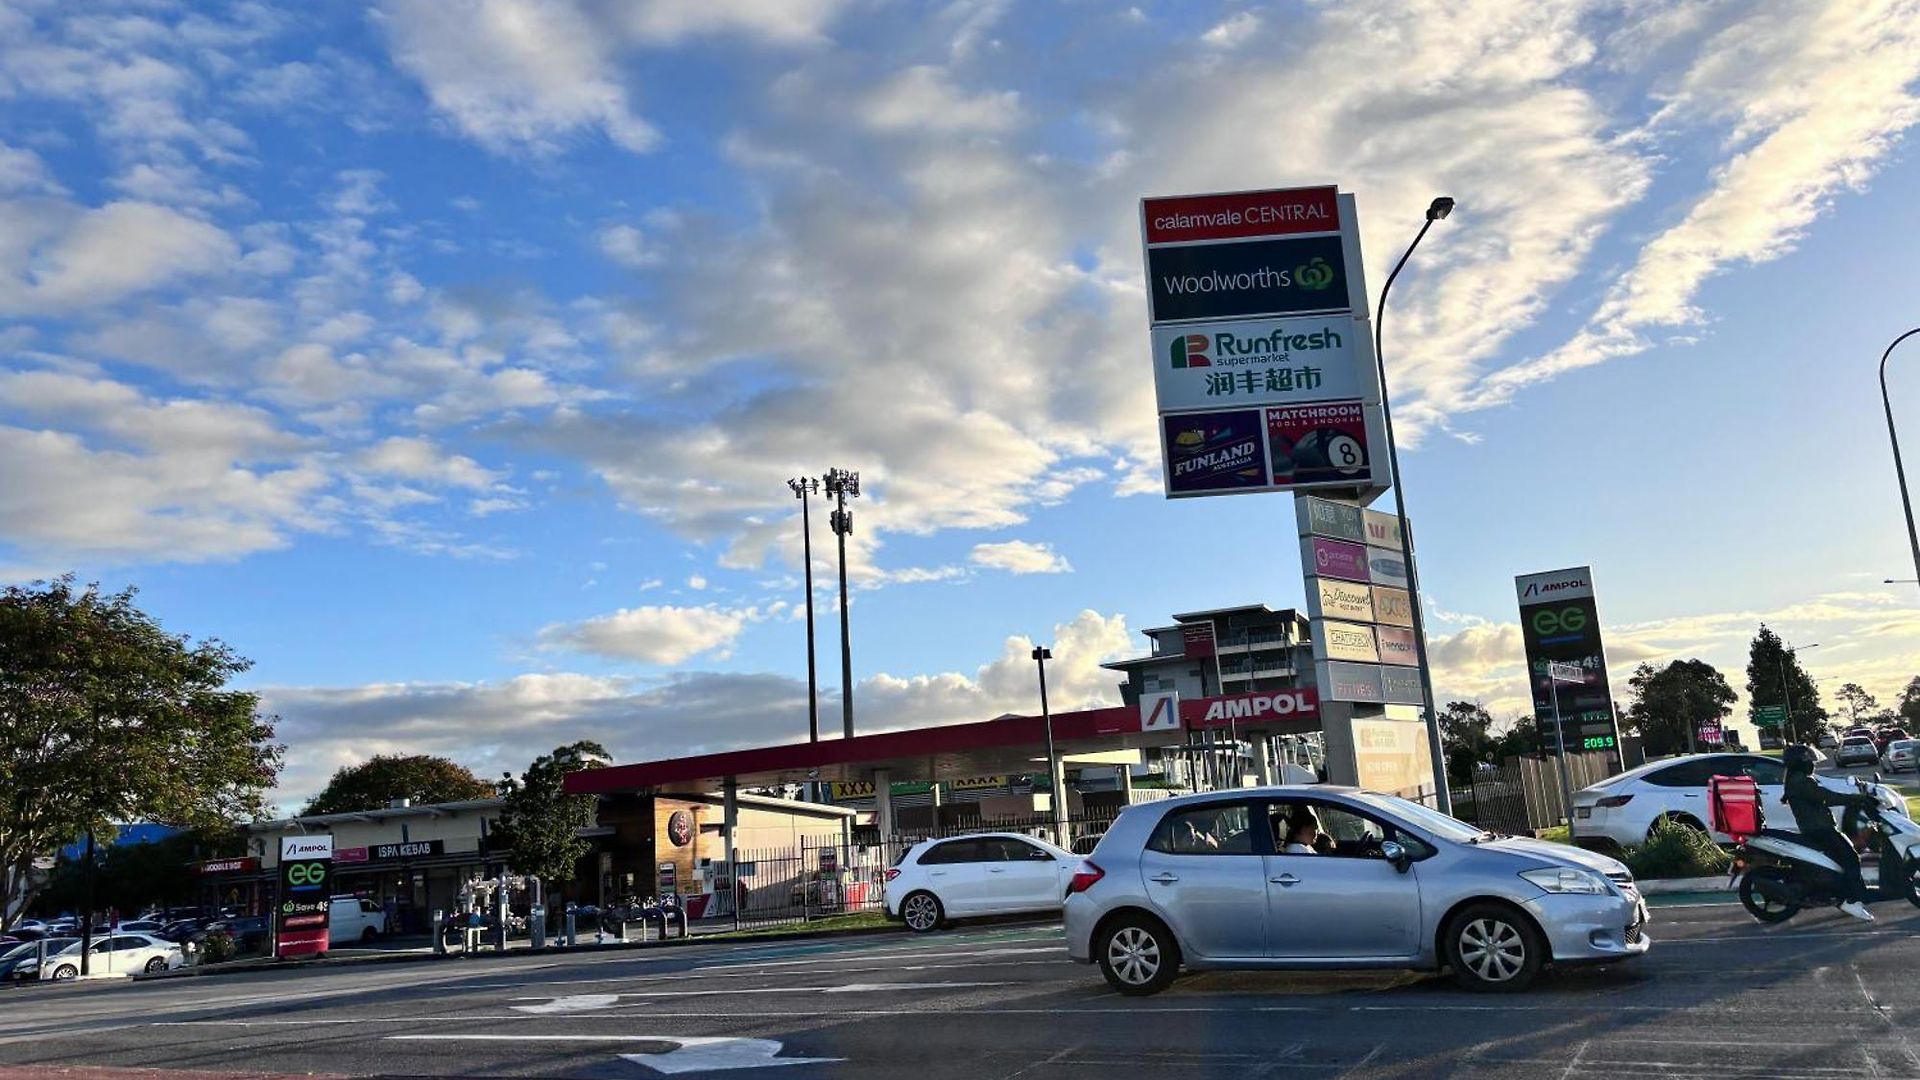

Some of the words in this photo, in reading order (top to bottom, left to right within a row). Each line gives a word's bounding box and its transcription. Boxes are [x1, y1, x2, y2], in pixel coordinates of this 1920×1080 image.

[1154, 208, 1242, 231] calamvale
[1244, 204, 1329, 225] CENTRAL
[1163, 265, 1291, 295] Woolworths
[1215, 327, 1342, 356] Runfresh
[1216, 352, 1290, 367] supermarket
[1205, 365, 1322, 396] 润丰超市
[1268, 406, 1361, 421] MATCHROOM
[1313, 416, 1362, 425] SNOOKER
[1174, 441, 1255, 477] FUNLAND
[1339, 443, 1356, 466] 8
[1212, 455, 1253, 472] AUSTRALIA
[1541, 578, 1588, 593] AMPOL
[1204, 693, 1315, 721] AMPOL
[1583, 736, 1614, 749] 209.9
[298, 843, 328, 853] AMPOL
[378, 844, 399, 857] ISPA
[400, 843, 431, 856] KEBAB
